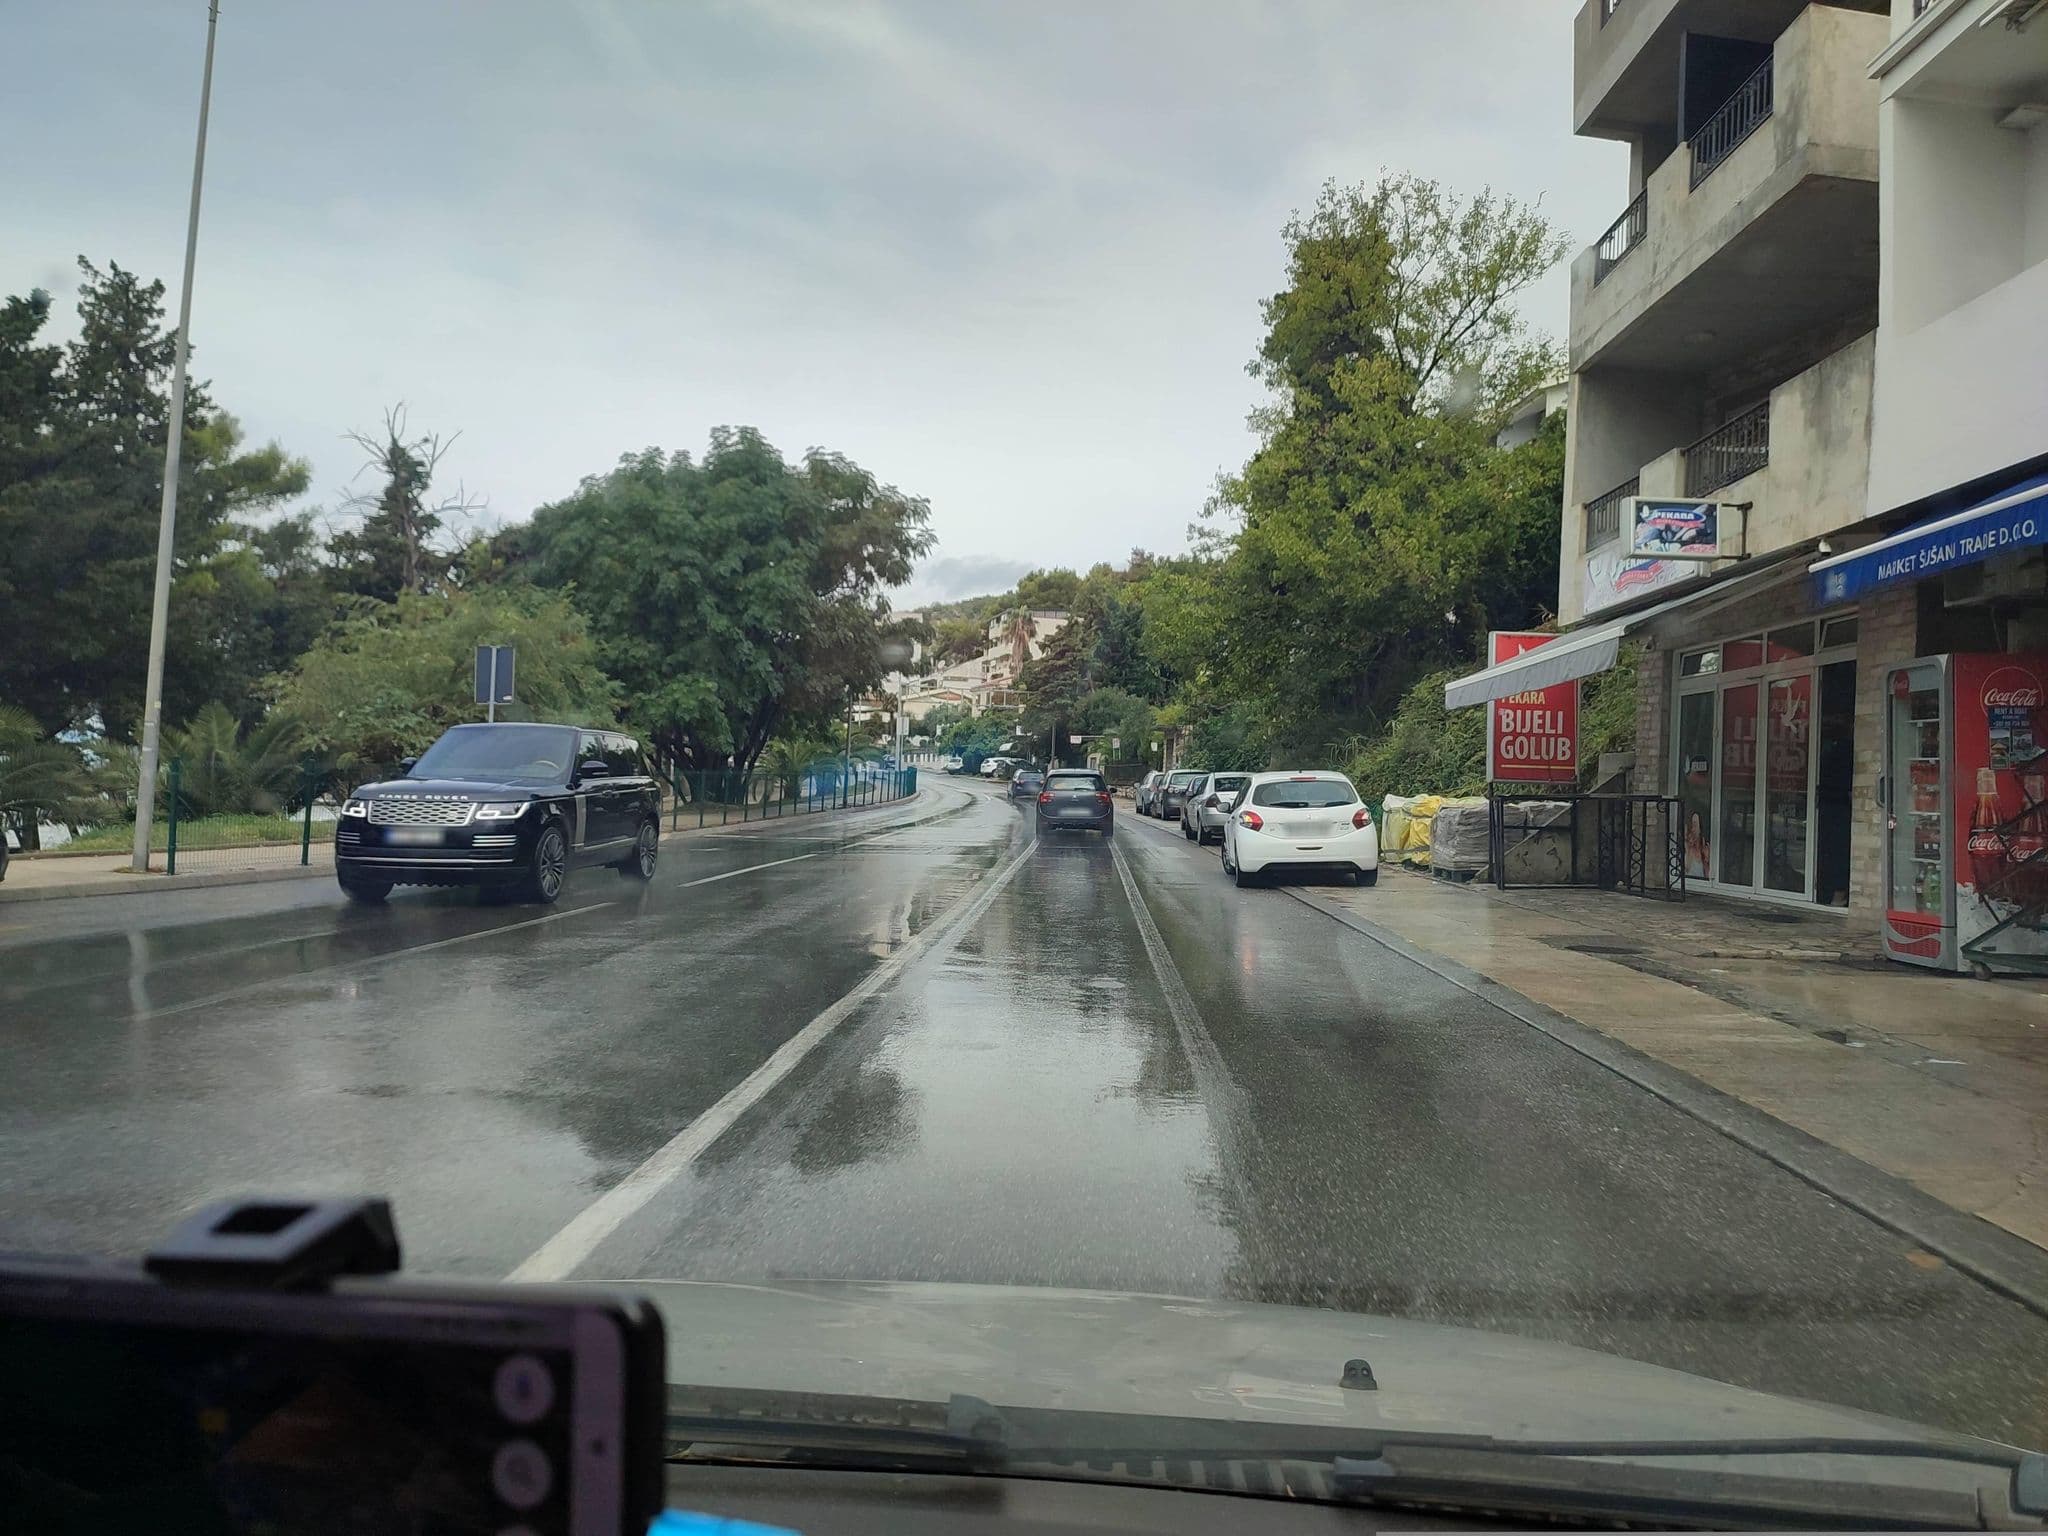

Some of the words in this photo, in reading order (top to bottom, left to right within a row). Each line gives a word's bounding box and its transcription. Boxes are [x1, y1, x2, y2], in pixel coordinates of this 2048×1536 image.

[1959, 530, 1996, 556] TRADE
[1501, 709, 1563, 734] BIJELI
[1500, 735, 1571, 760] GOLUB
